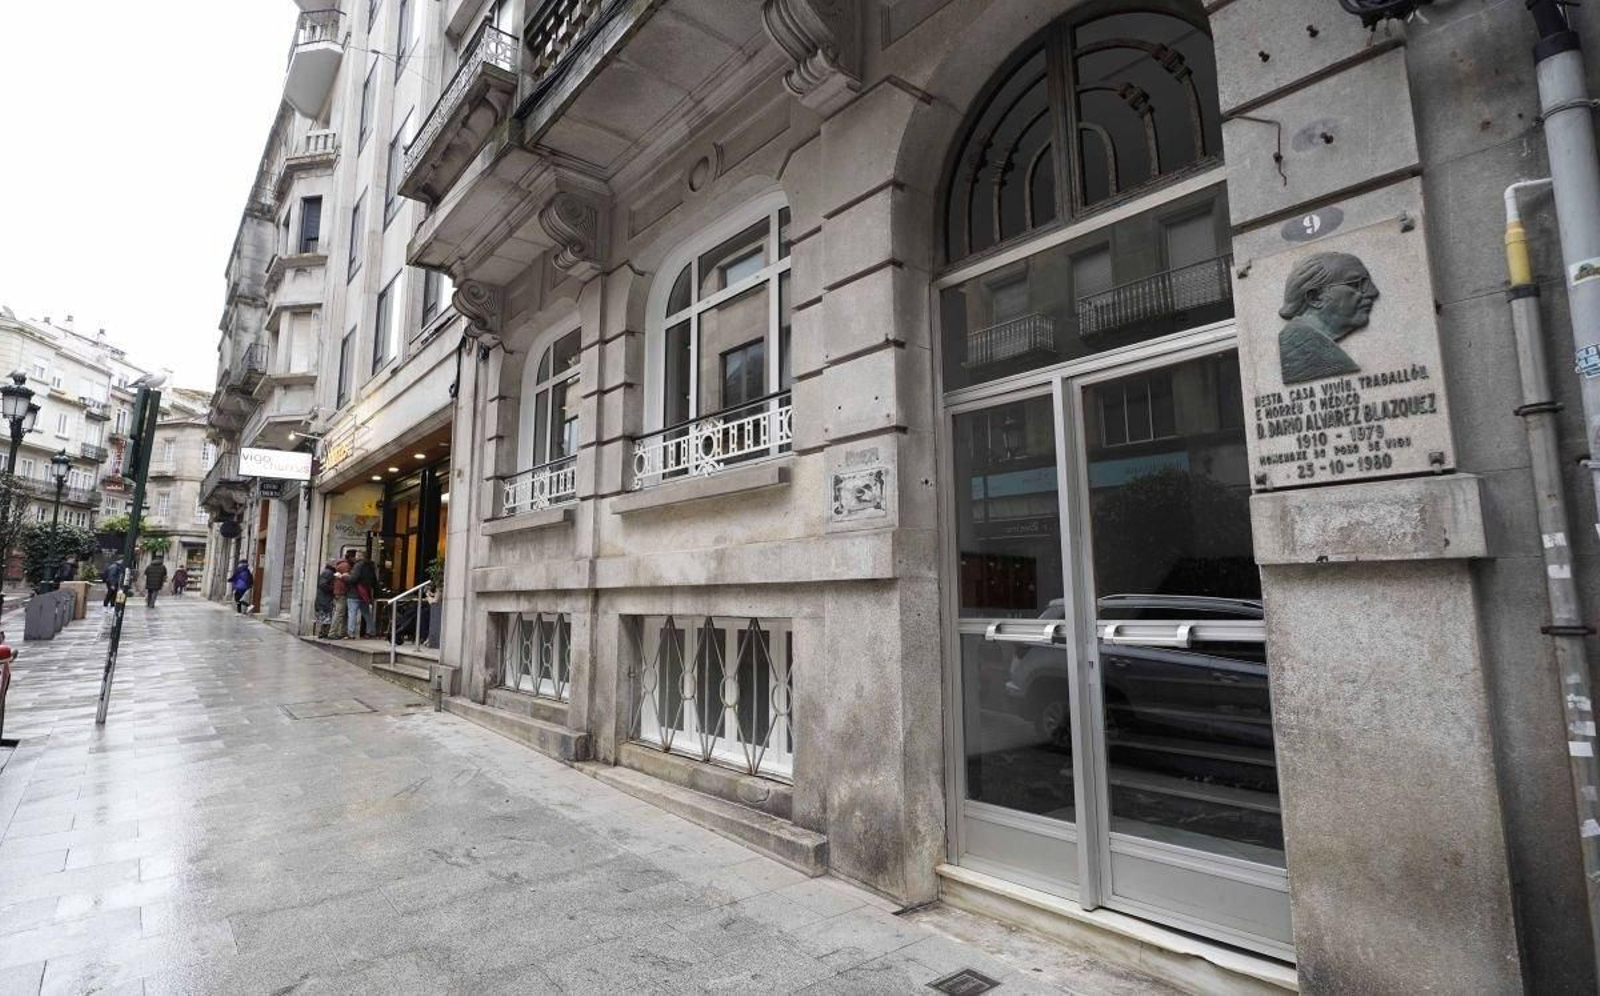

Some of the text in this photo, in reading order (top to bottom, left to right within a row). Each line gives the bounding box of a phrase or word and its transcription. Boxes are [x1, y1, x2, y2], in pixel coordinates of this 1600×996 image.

[1303, 214, 1320, 234] 9
[1255, 392, 1283, 408] NESTA
[1289, 386, 1316, 402] CASA
[1256, 408, 1262, 421] E
[1309, 400, 1317, 412] O
[1296, 431, 1328, 449] 1910
[1350, 424, 1385, 442] 1979
[1385, 436, 1411, 449] VIGO
[242, 452, 272, 465] vigo
